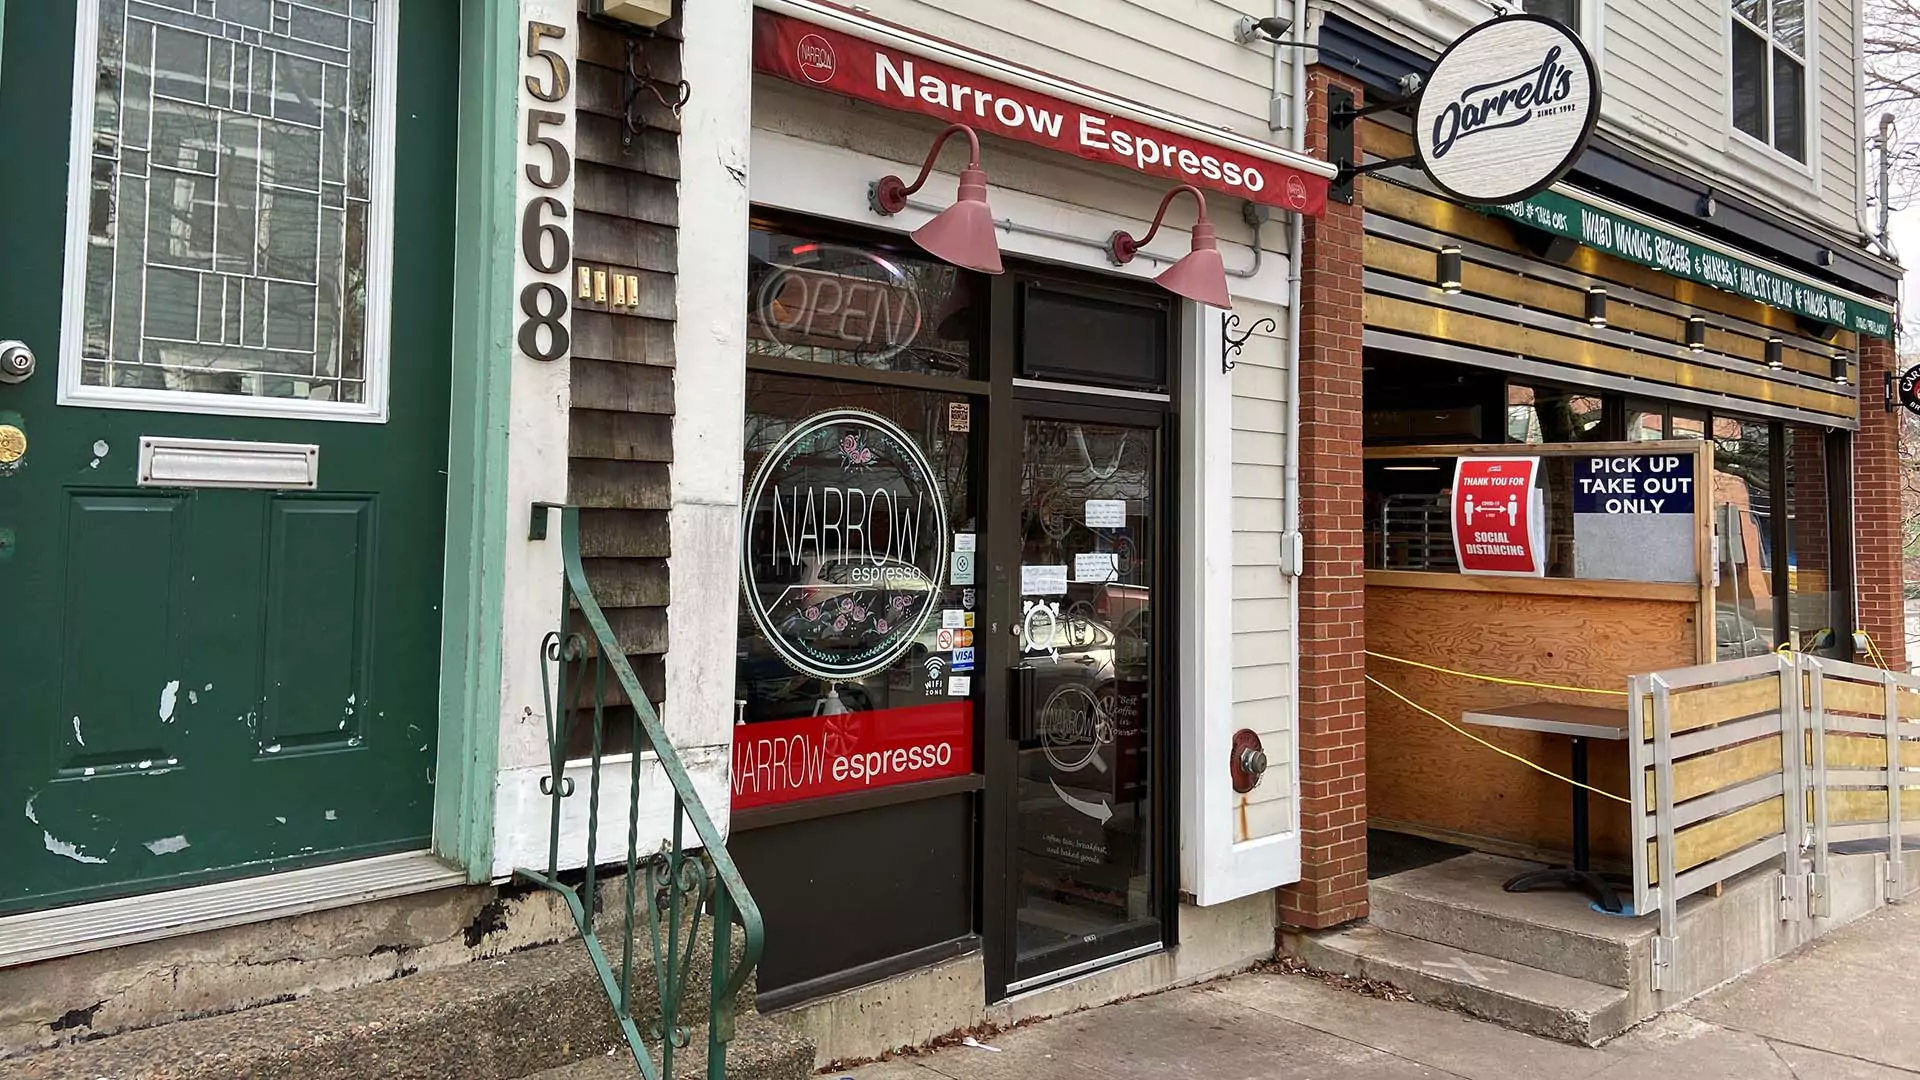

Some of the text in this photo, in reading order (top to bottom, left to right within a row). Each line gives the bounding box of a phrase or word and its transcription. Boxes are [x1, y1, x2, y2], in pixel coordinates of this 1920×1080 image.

[1432, 46, 1573, 159] Darrell's
[1537, 104, 1576, 118] SINCE 1992
[875, 52, 1265, 194] Narrow Espresso
[518, 21, 570, 362] 5568
[1552, 211, 1569, 232] OUT
[1581, 208, 1612, 249] AWARD
[1614, 221, 1653, 262] WINNING
[1702, 253, 1734, 287] SHAKES
[770, 273, 908, 347] OPEN
[1591, 456, 1680, 473] PICK UP
[1463, 477, 1525, 486] THANK YOU FOR
[1580, 477, 1692, 495] TAKE OUT
[1605, 498, 1665, 514] ONLY
[772, 485, 924, 567] NARROW
[1474, 531, 1510, 543] SOCIAL
[1465, 544, 1526, 556] DISTANCING
[851, 567, 922, 583] espresso
[955, 650, 973, 661] VISA
[924, 680, 943, 689] WIFI
[730, 732, 952, 796] NARROW espresso
